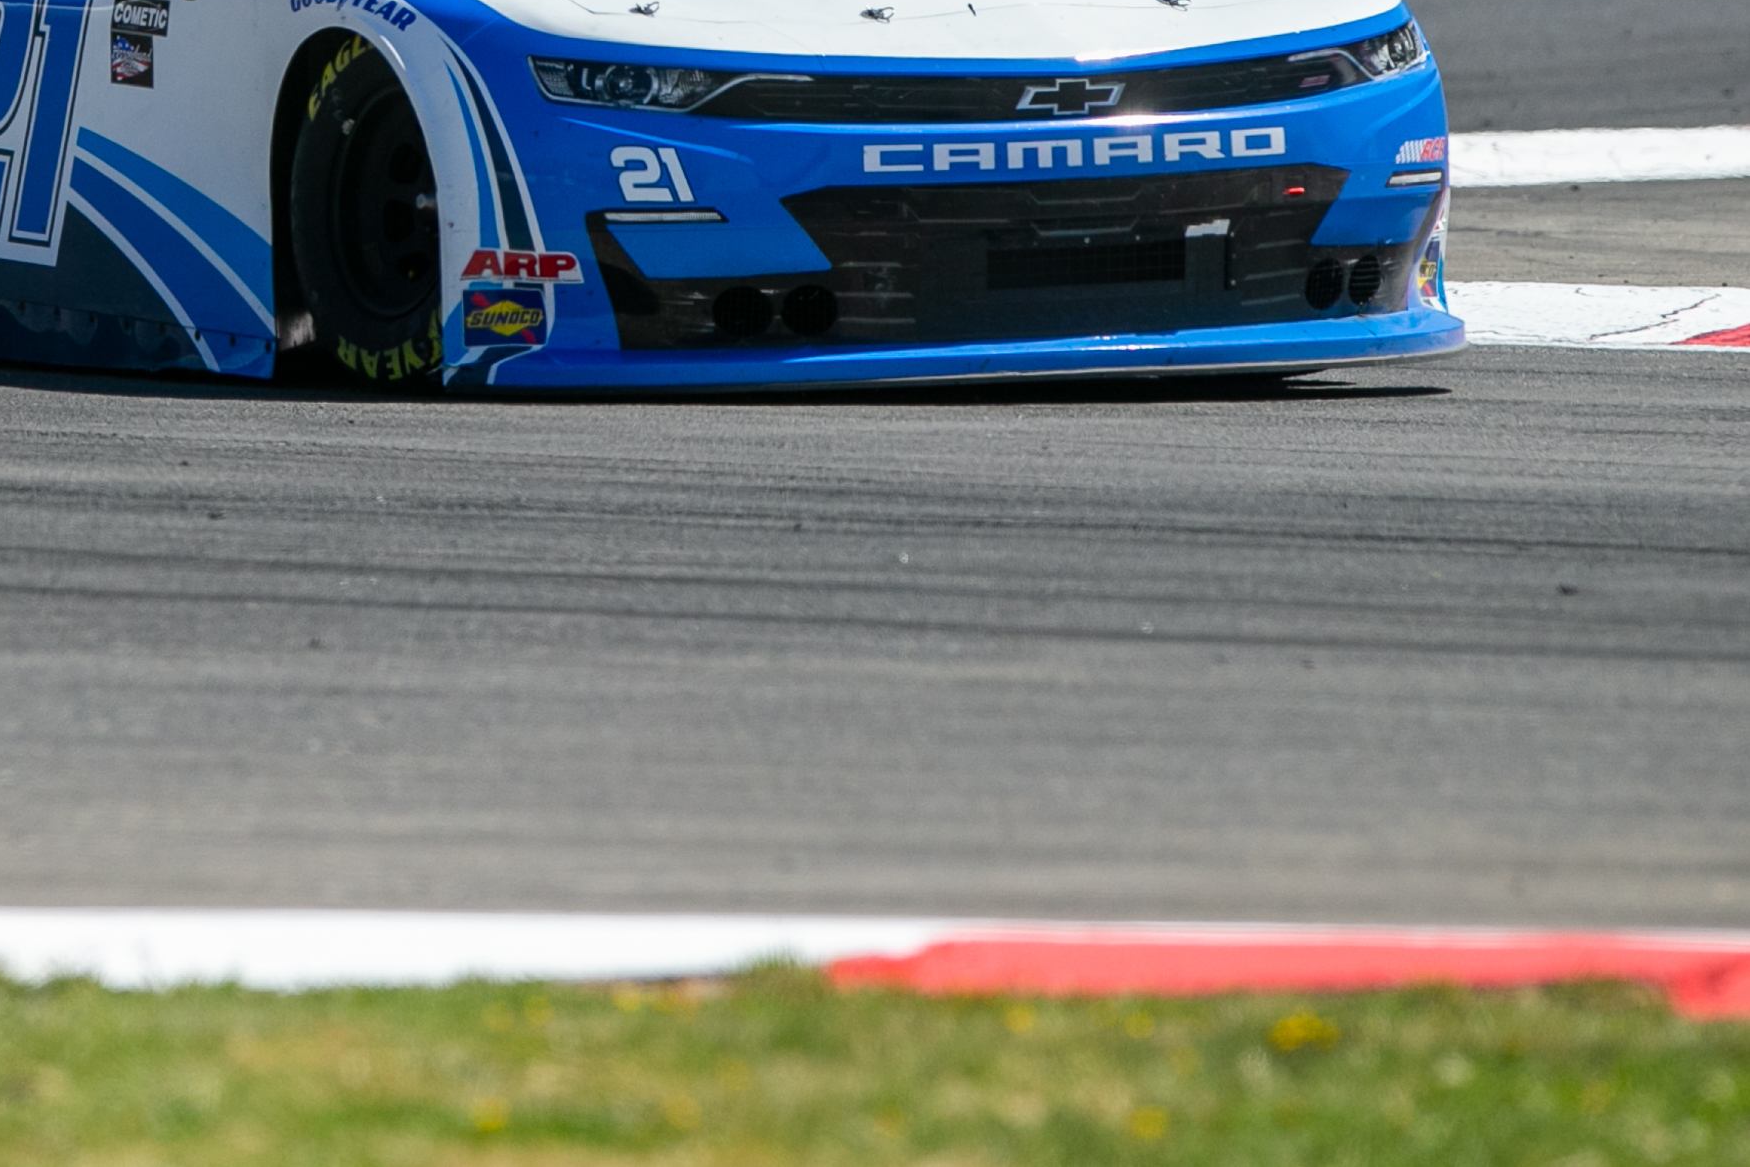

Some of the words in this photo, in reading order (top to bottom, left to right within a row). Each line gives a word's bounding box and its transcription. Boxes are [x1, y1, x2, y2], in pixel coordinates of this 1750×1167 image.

[113, 2, 168, 30] COMETIC
[863, 126, 1287, 173] CAMARO
[610, 145, 696, 204] 21
[461, 249, 578, 279] ARP
[468, 308, 543, 328] SUNOCO
